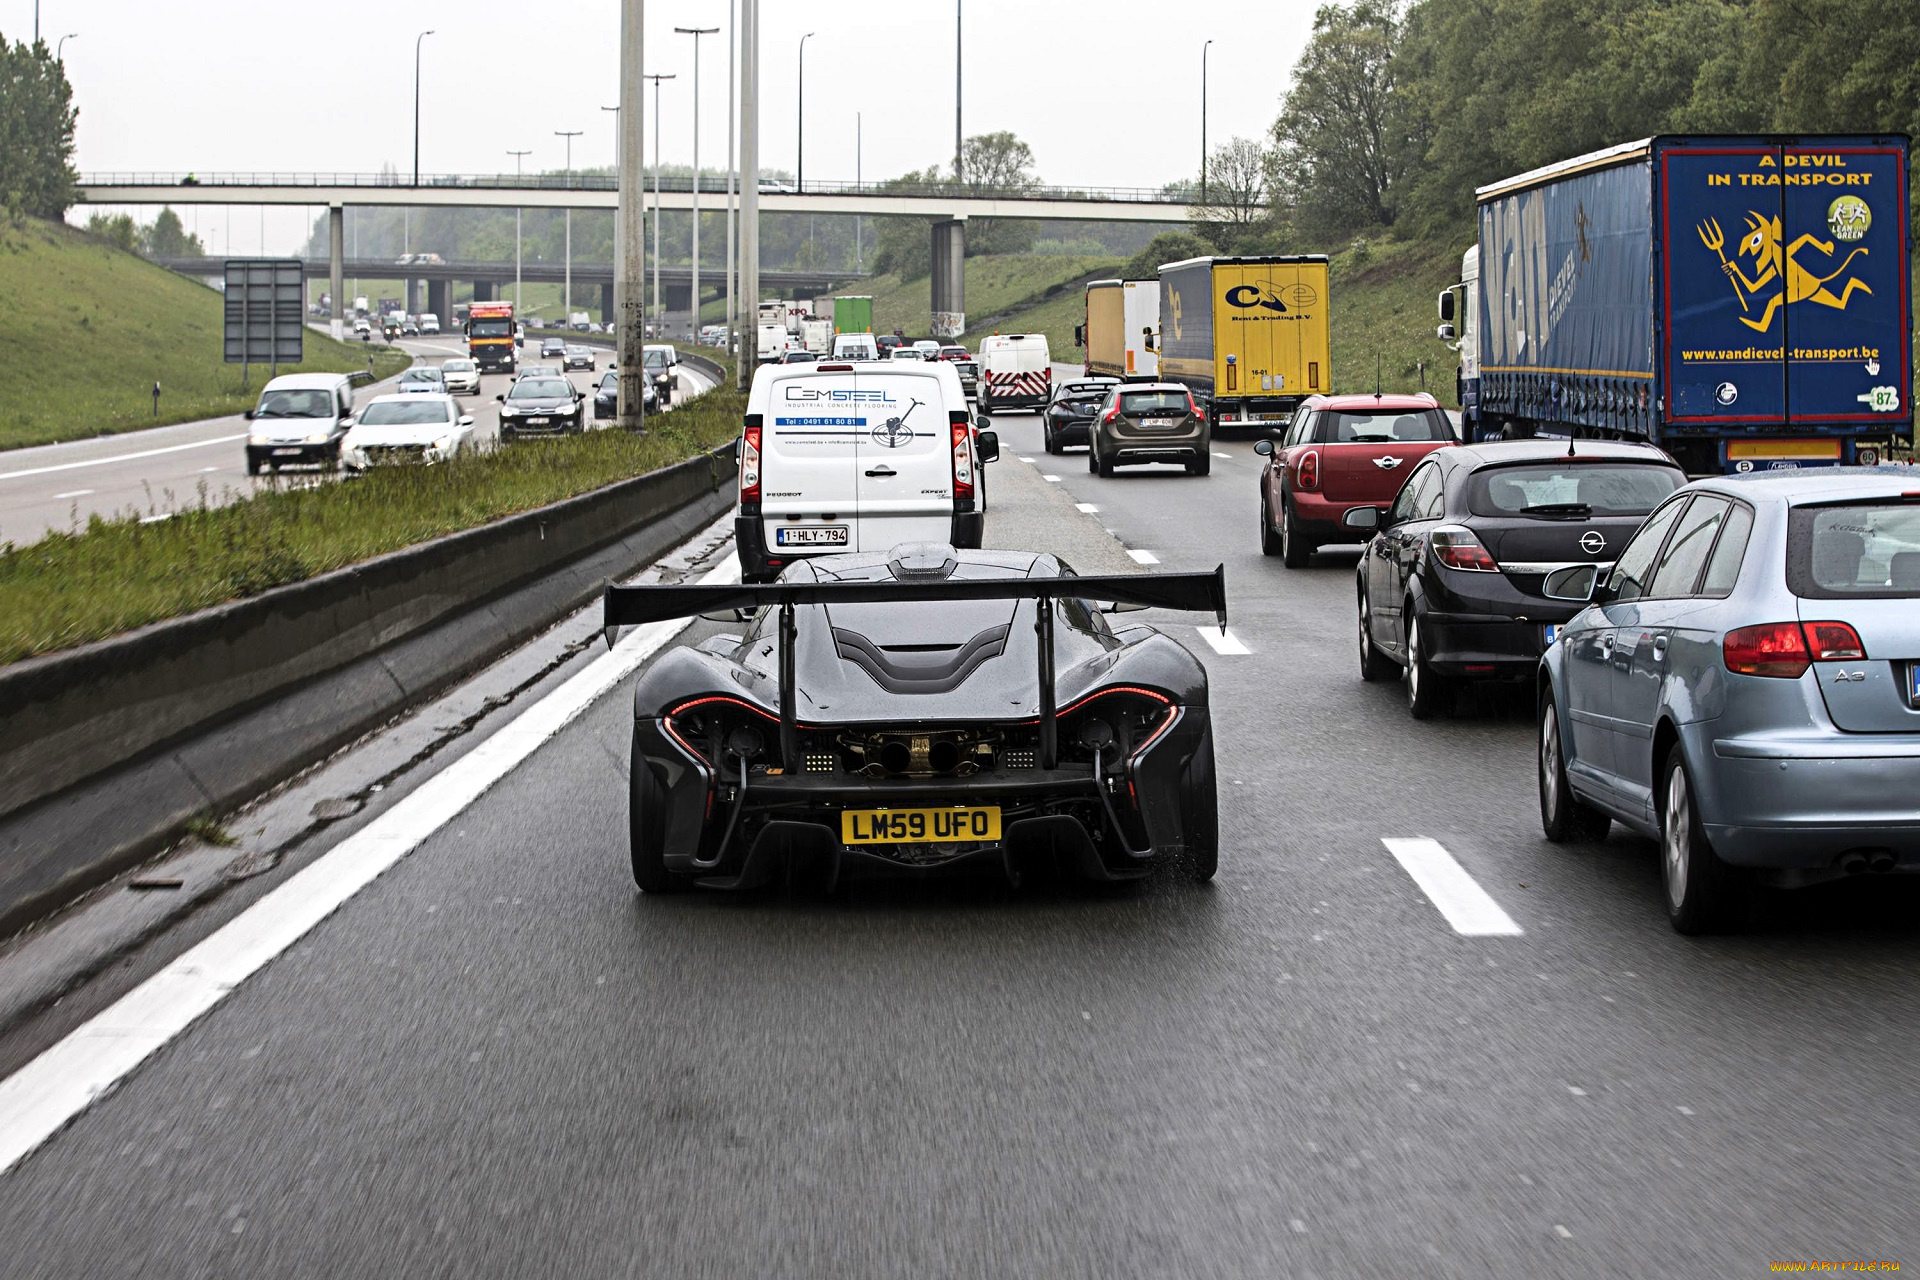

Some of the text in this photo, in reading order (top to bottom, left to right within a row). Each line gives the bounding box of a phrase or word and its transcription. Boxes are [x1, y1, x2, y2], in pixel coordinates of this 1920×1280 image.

[1758, 155, 1847, 167] A DEVIL
[1707, 173, 1873, 186] IN TRANSPORT
[1832, 225, 1853, 233] LEAN
[1837, 231, 1864, 240] GREEN
[788, 308, 808, 316] XPO
[1876, 392, 1892, 406] 87
[1834, 668, 1865, 683] A3
[852, 810, 988, 840] LM59 UFO
